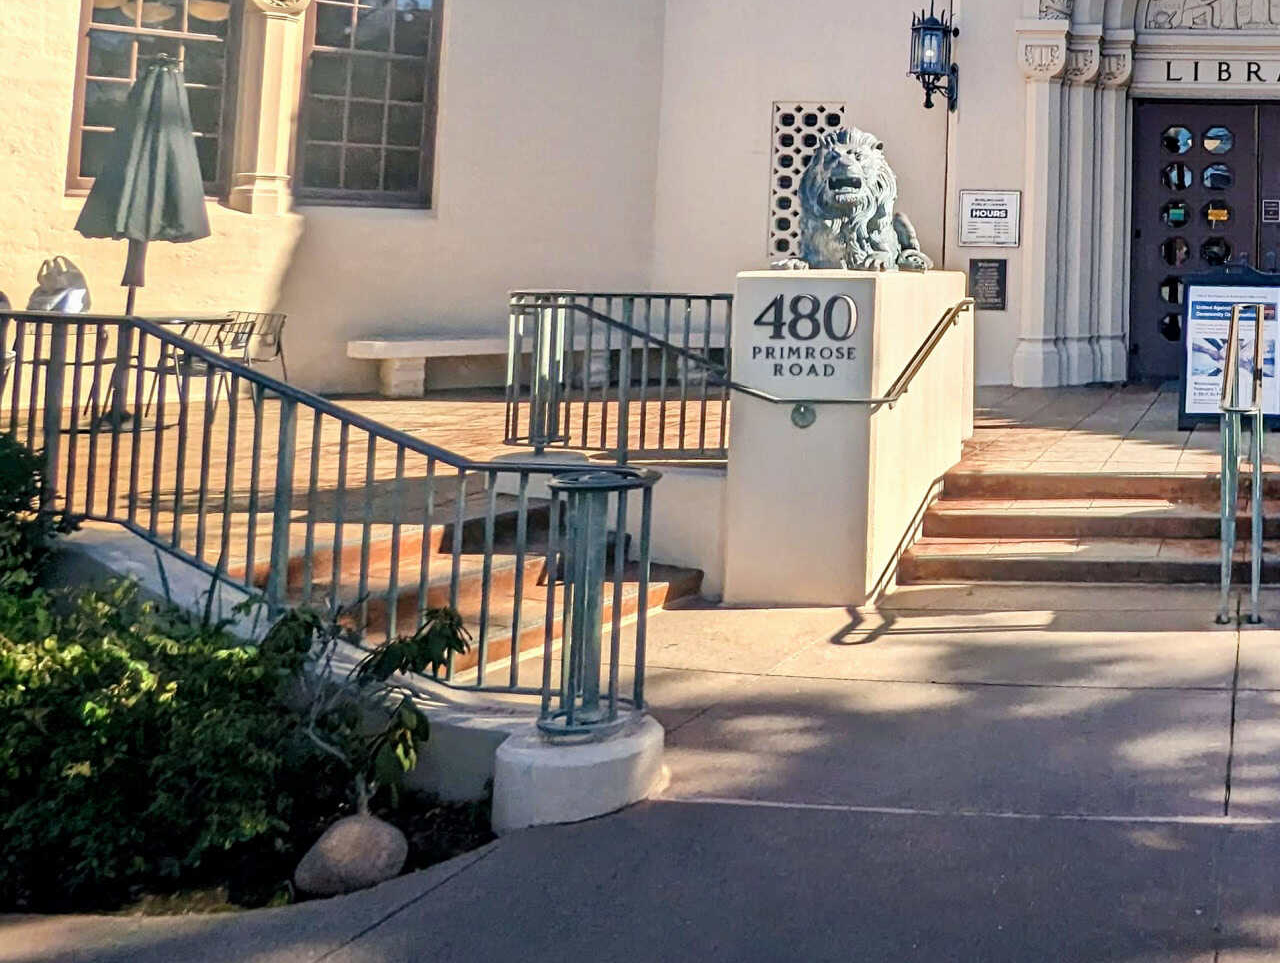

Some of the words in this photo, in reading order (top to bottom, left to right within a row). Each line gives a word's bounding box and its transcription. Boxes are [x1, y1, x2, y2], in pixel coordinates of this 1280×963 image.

[972, 209, 1006, 217] HOURS
[753, 293, 859, 342] 480
[752, 346, 857, 360] PRIMROSE
[773, 363, 835, 377] ROAD
